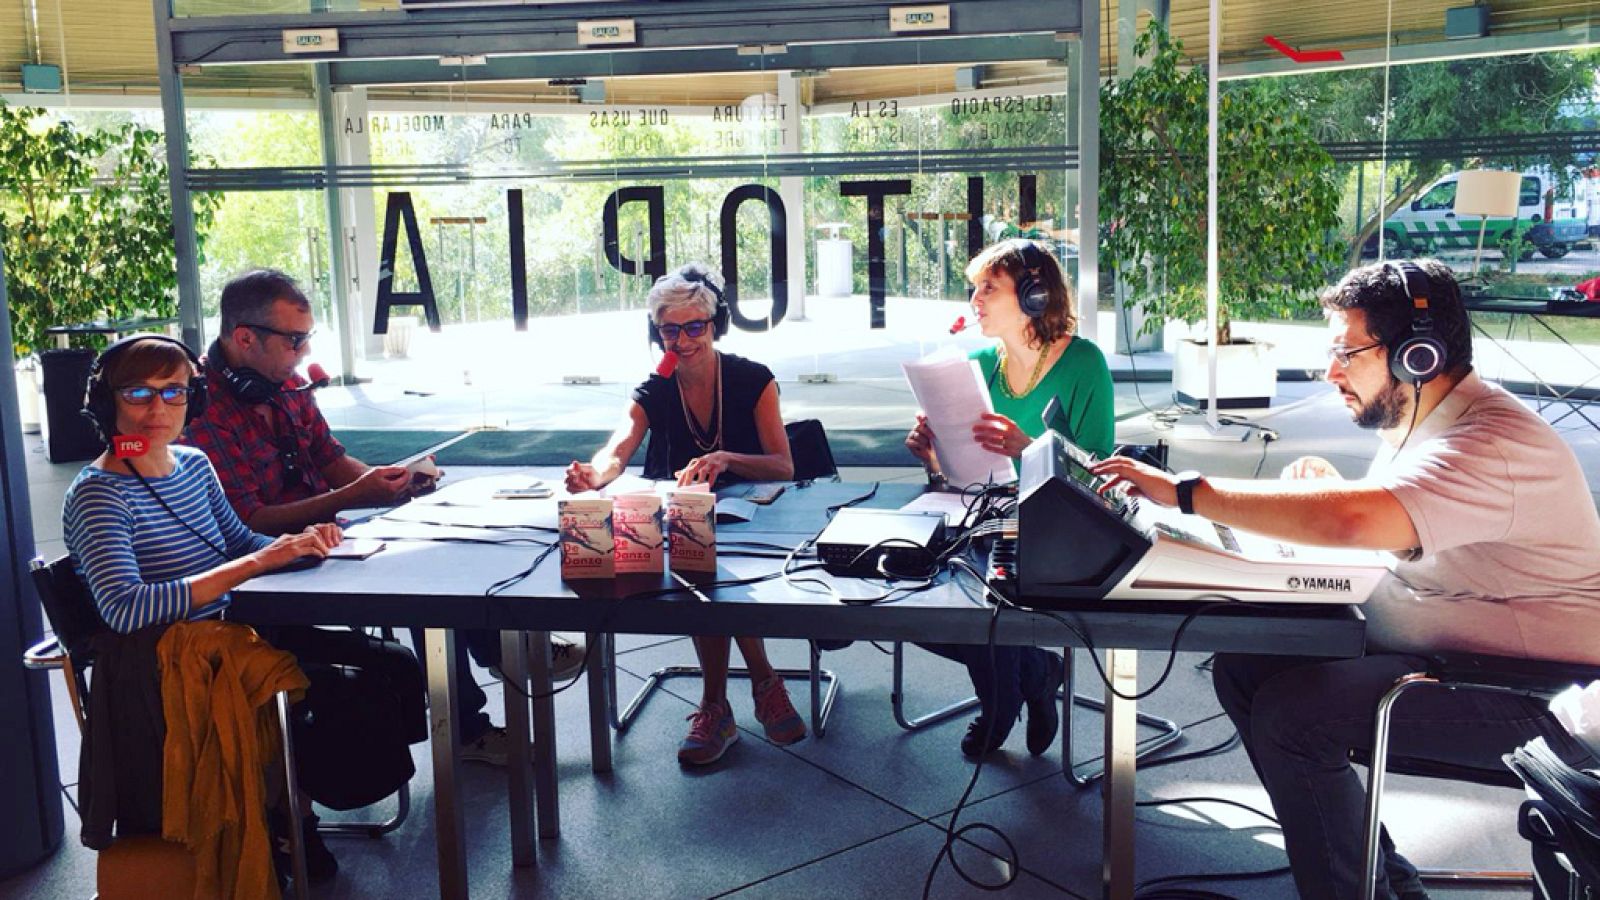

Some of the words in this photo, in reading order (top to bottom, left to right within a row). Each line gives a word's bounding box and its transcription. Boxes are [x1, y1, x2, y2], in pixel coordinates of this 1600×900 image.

[906, 13, 933, 23] SALIDA
[592, 26, 619, 36] SALIDA
[297, 35, 320, 45] SALIDA
[614, 551, 651, 560] Danza
[564, 557, 602, 565] Danza
[1302, 577, 1351, 592] YAMAHA
